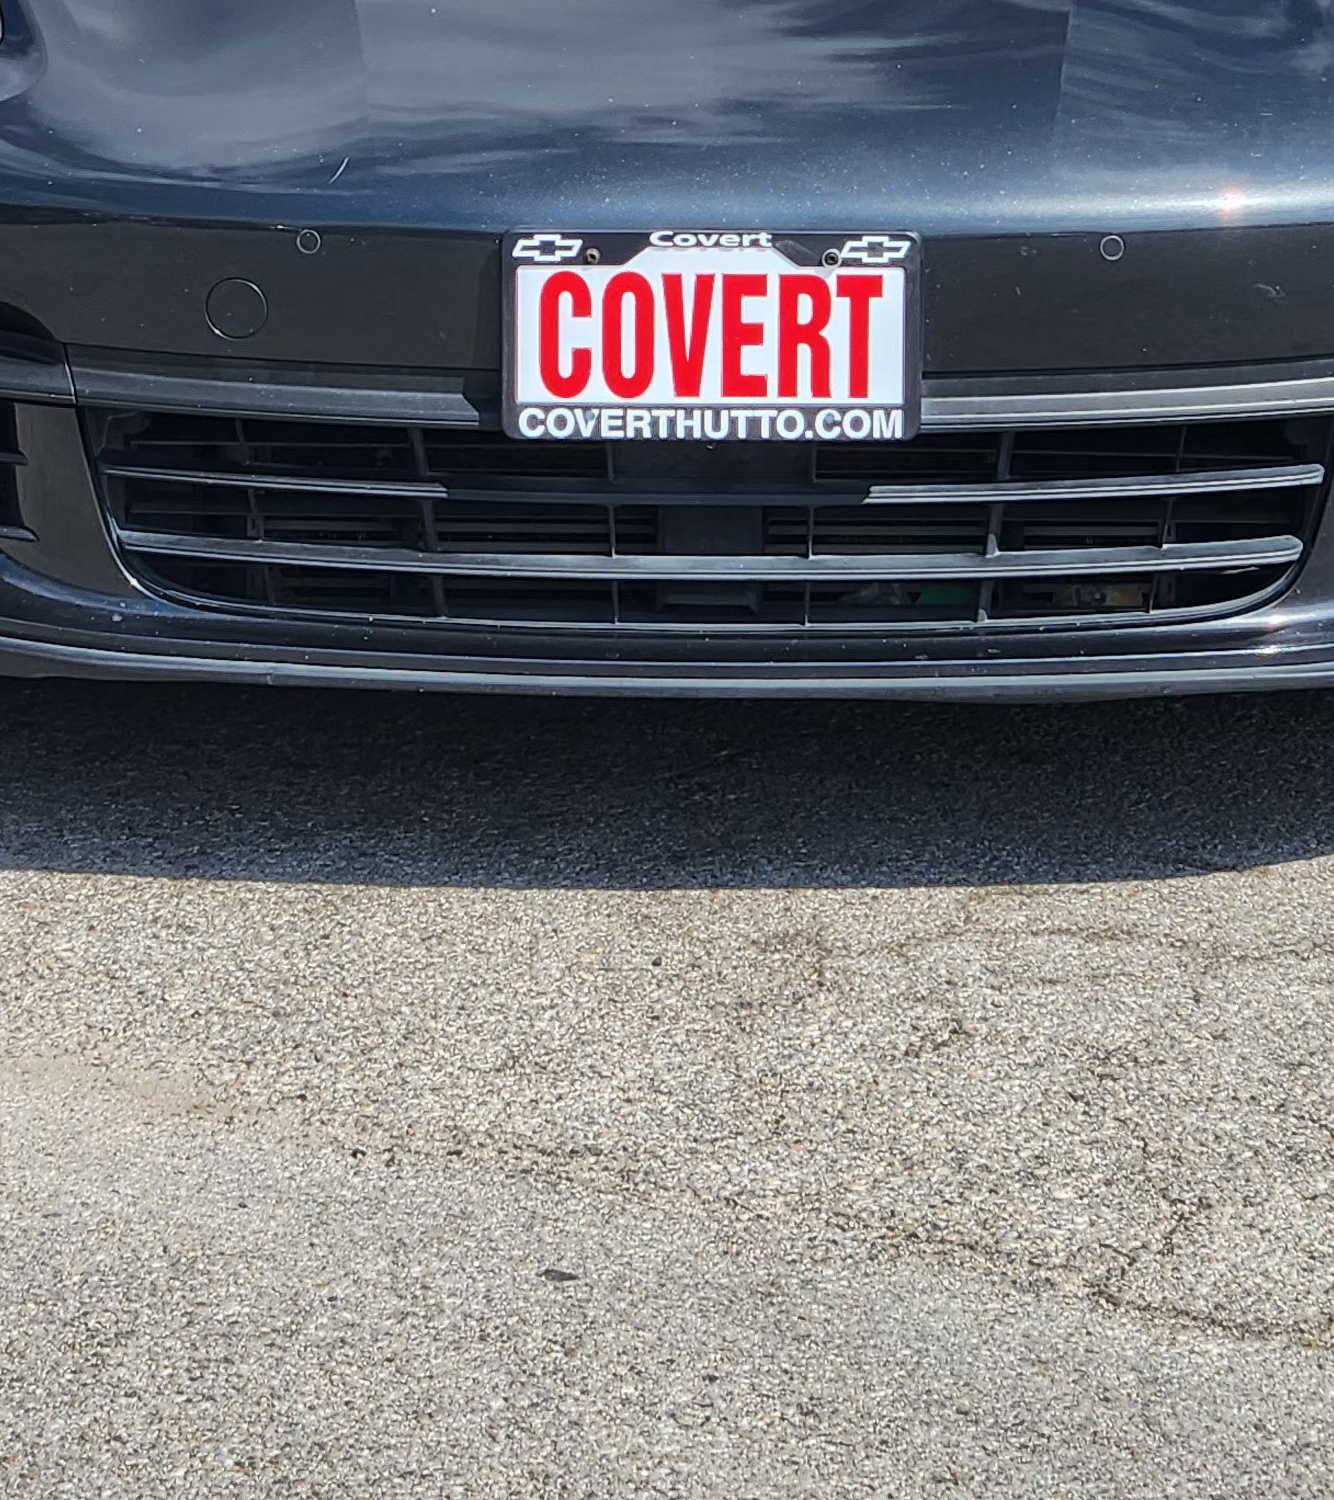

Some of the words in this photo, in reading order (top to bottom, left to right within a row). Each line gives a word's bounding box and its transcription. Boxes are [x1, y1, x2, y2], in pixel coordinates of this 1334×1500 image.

[649, 230, 773, 248] Covert
[538, 270, 884, 399] COVERT
[517, 407, 904, 440] COVERTHUTTO.COM
